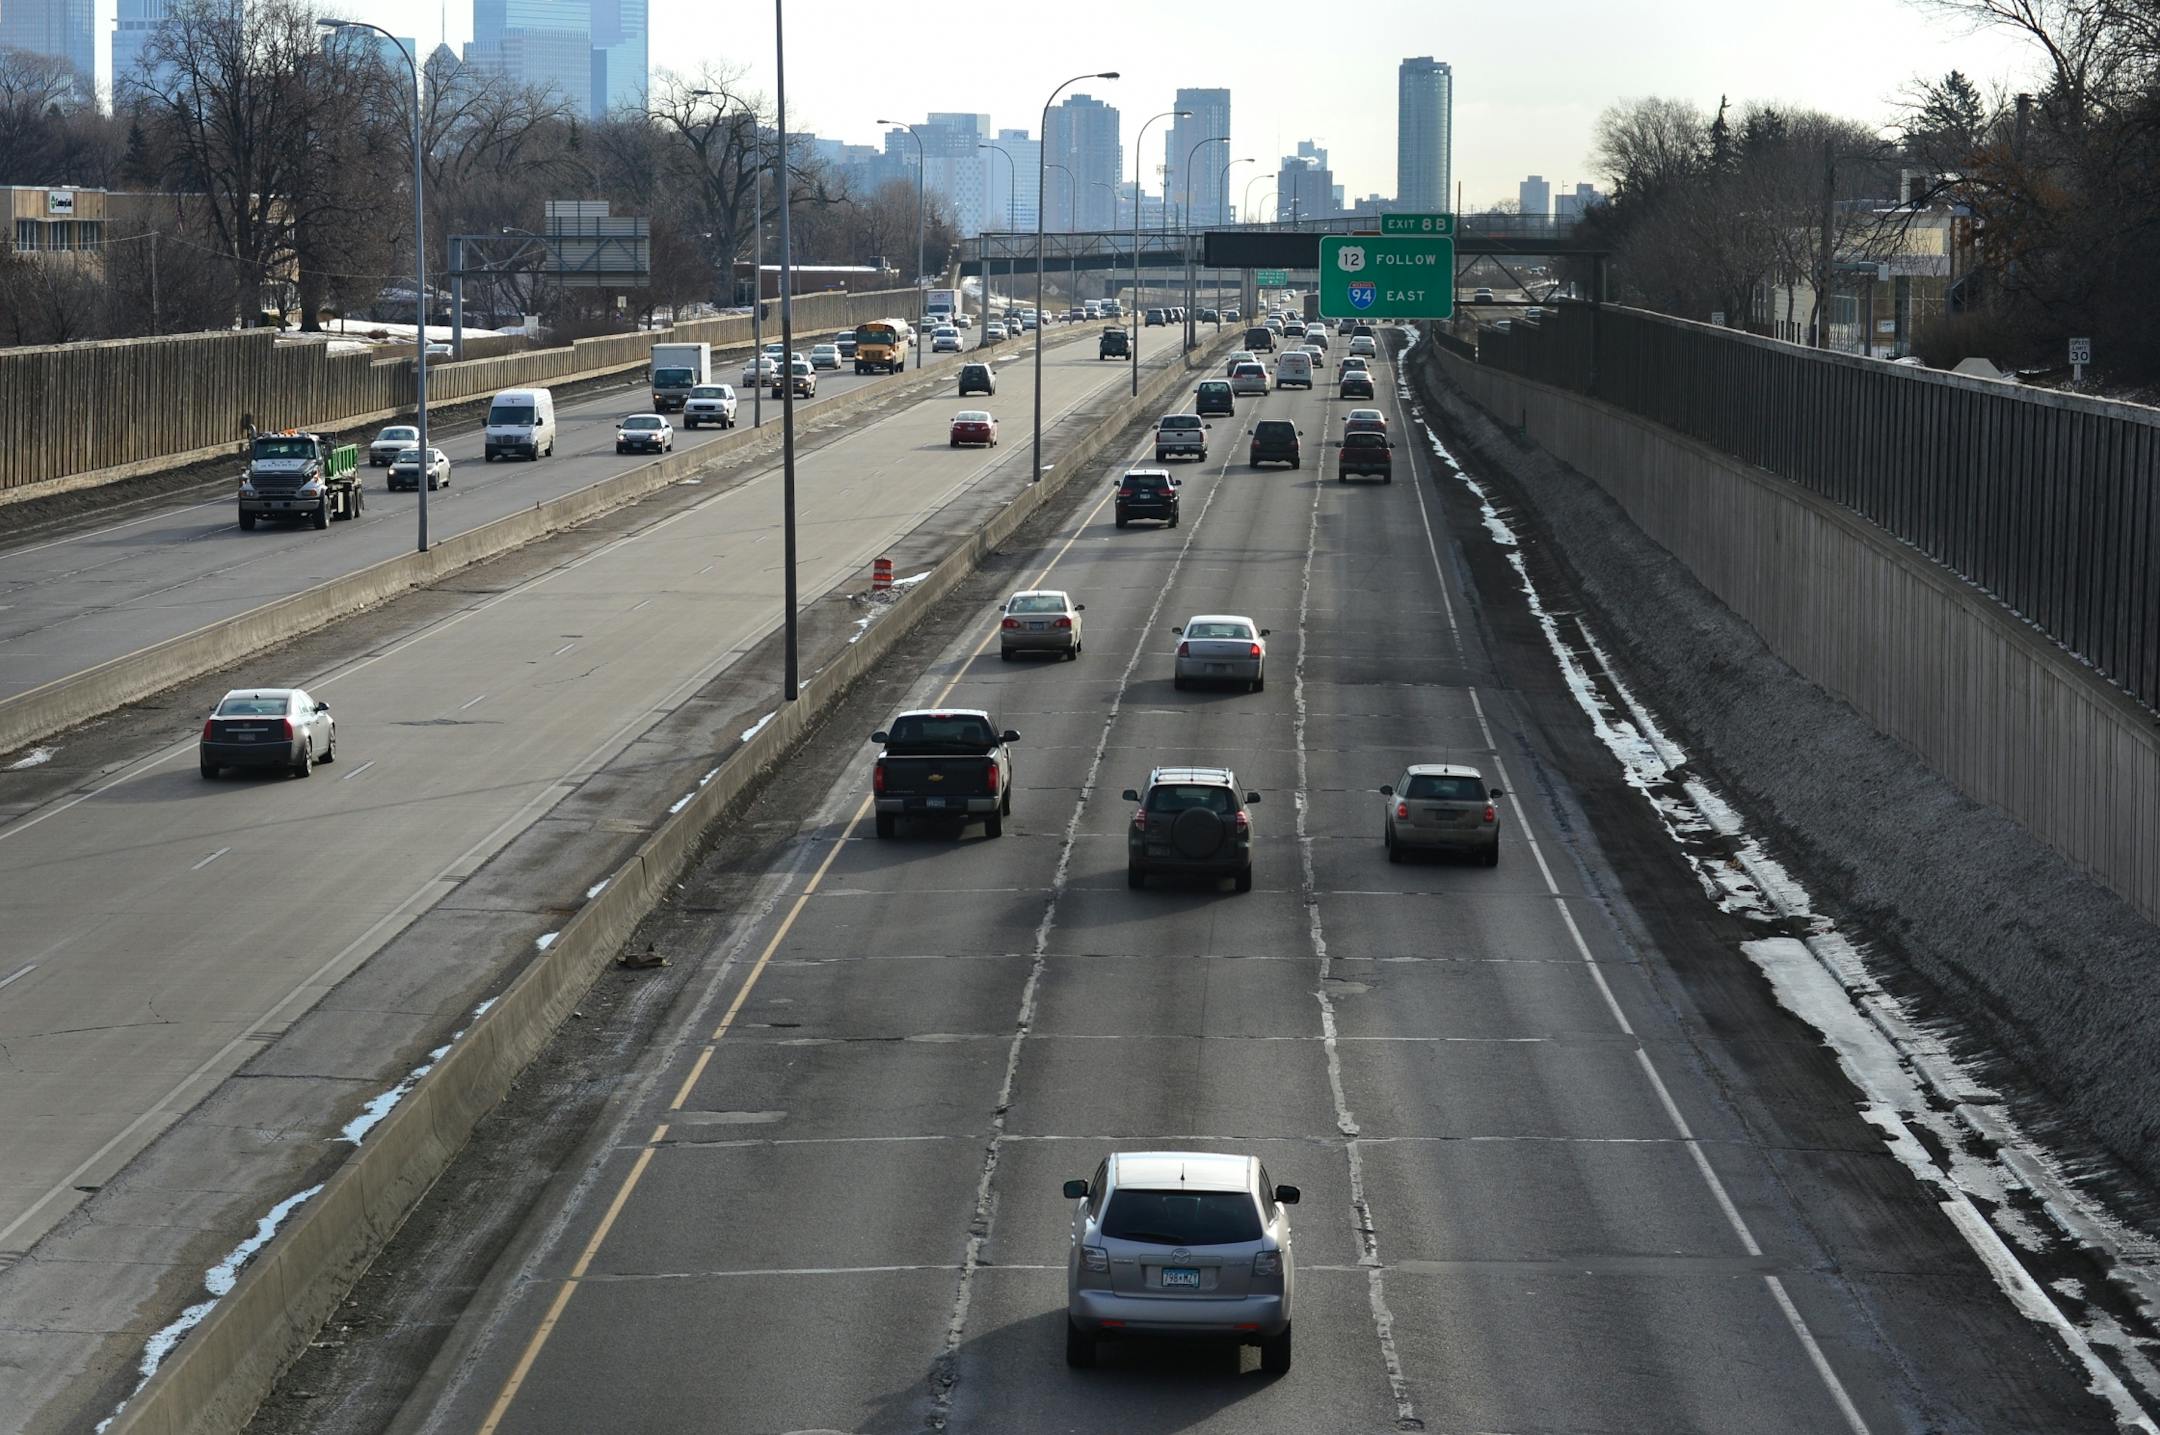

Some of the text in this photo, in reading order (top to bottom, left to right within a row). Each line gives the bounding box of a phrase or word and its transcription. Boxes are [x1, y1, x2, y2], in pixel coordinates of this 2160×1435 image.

[1388, 218, 1446, 231] EXIT 8B
[1344, 253, 1436, 266] 12 FOLLOW
[1352, 289, 1425, 302] 94 EAST
[2071, 351, 2088, 360] 30
